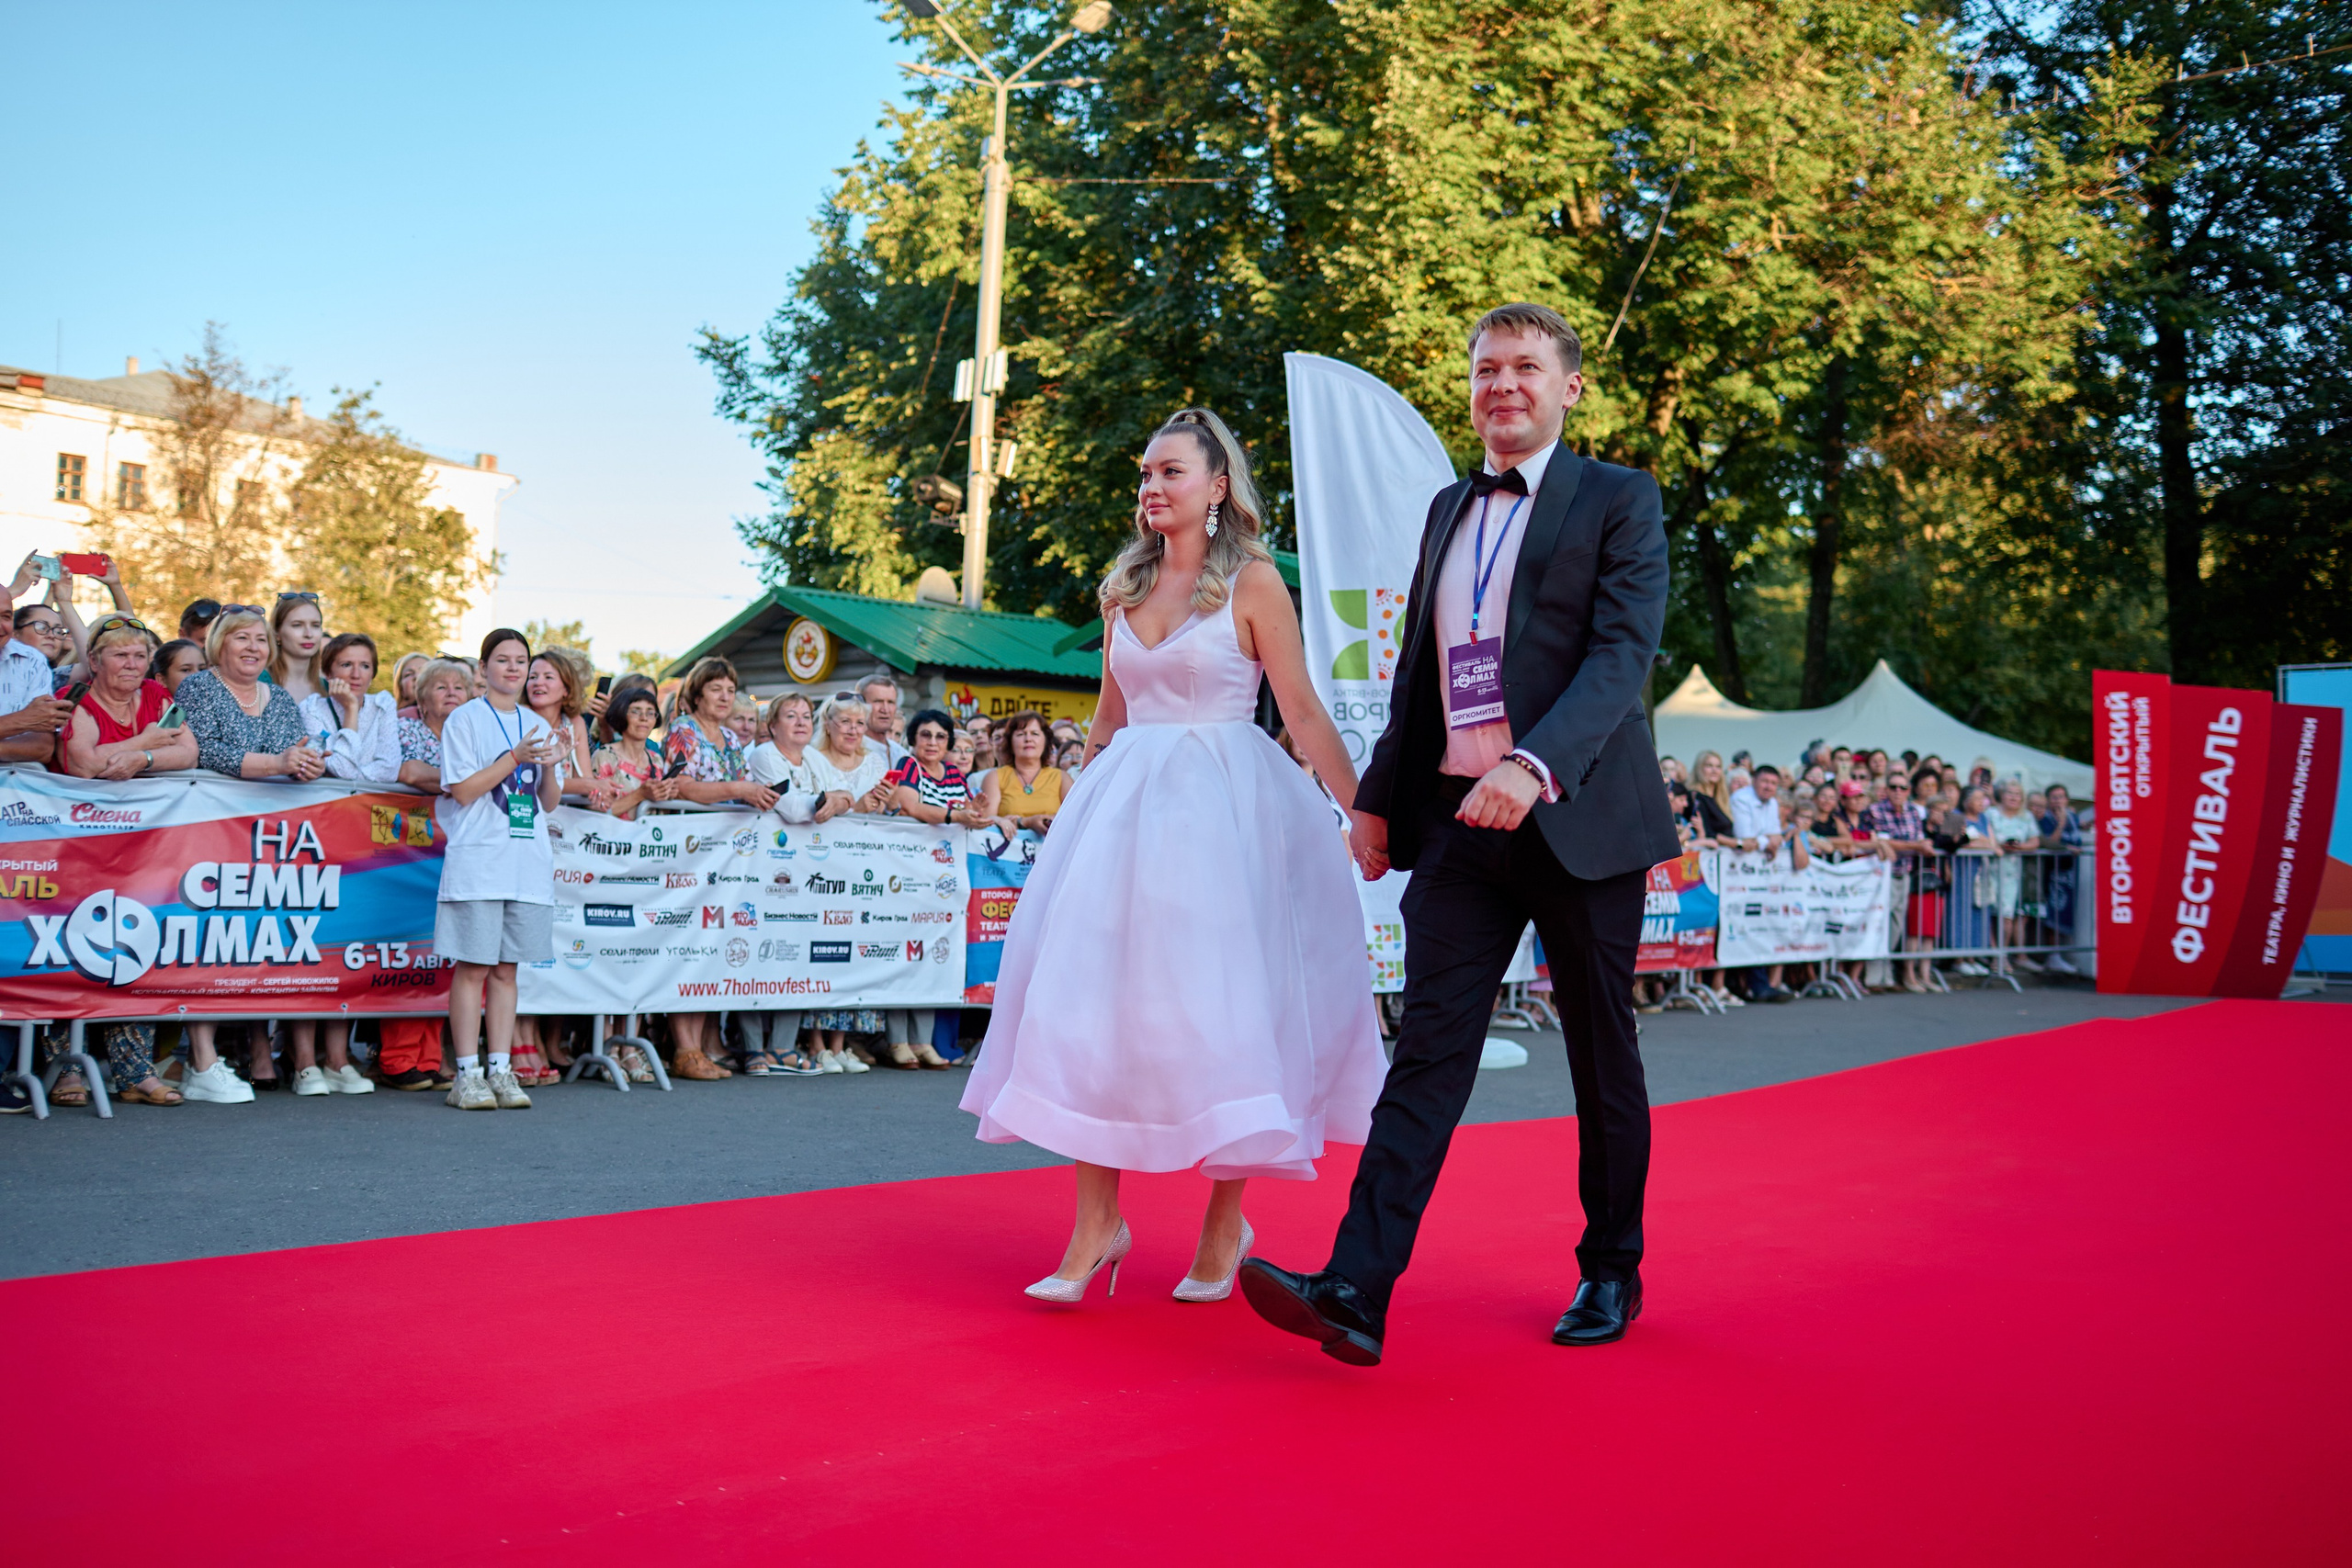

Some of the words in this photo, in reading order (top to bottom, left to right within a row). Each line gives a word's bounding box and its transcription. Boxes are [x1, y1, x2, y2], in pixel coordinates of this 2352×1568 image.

[1483, 655, 1495, 664] НА
[1473, 661, 1498, 674] СЕМИ
[990, 695, 1052, 720] ДАЙТЕ
[1453, 706, 1500, 721] ОРГКОМИТЕТ
[2104, 691, 2132, 812] ВЯТСКИЙ
[2132, 696, 2152, 797] ОТКРЫТЫЙ
[2284, 716, 2318, 841] ЖУРНАЛИСТИКИ
[23, 807, 34, 817] НА
[70, 802, 142, 824] Смена
[7, 815, 61, 828] СПАССКОЙ
[253, 818, 325, 862] НА
[732, 832, 759, 850] МОРЕ
[2171, 706, 2243, 964] ФЕСТИВАЛЬ
[639, 843, 677, 858] ВЯТИЧ
[2281, 847, 2295, 860] И
[2105, 817, 2133, 924] ВТОРОЙ
[181, 862, 342, 909] СЕМИ
[744, 874, 760, 884] Град
[935, 876, 958, 893] МОРЕ
[2273, 861, 2293, 904] КИНО
[852, 883, 883, 897] ВЯТИЧ
[980, 889, 1013, 899] ВТОРОЙ
[587, 908, 629, 918] KIROV.RU
[873, 914, 892, 922] Киров
[910, 912, 944, 924] МАРИЯ
[344, 942, 411, 970] 6-13
[812, 945, 849, 953] KIROV.RU
[215, 978, 257, 987] ПРЕЗИДЕНТ
[263, 976, 290, 986] СЕРГЕЙ
[292, 976, 339, 985] НОВОЖИЛОВ
[370, 973, 435, 987] КИРОВ
[678, 976, 831, 997] www.7holmovfest.ru
